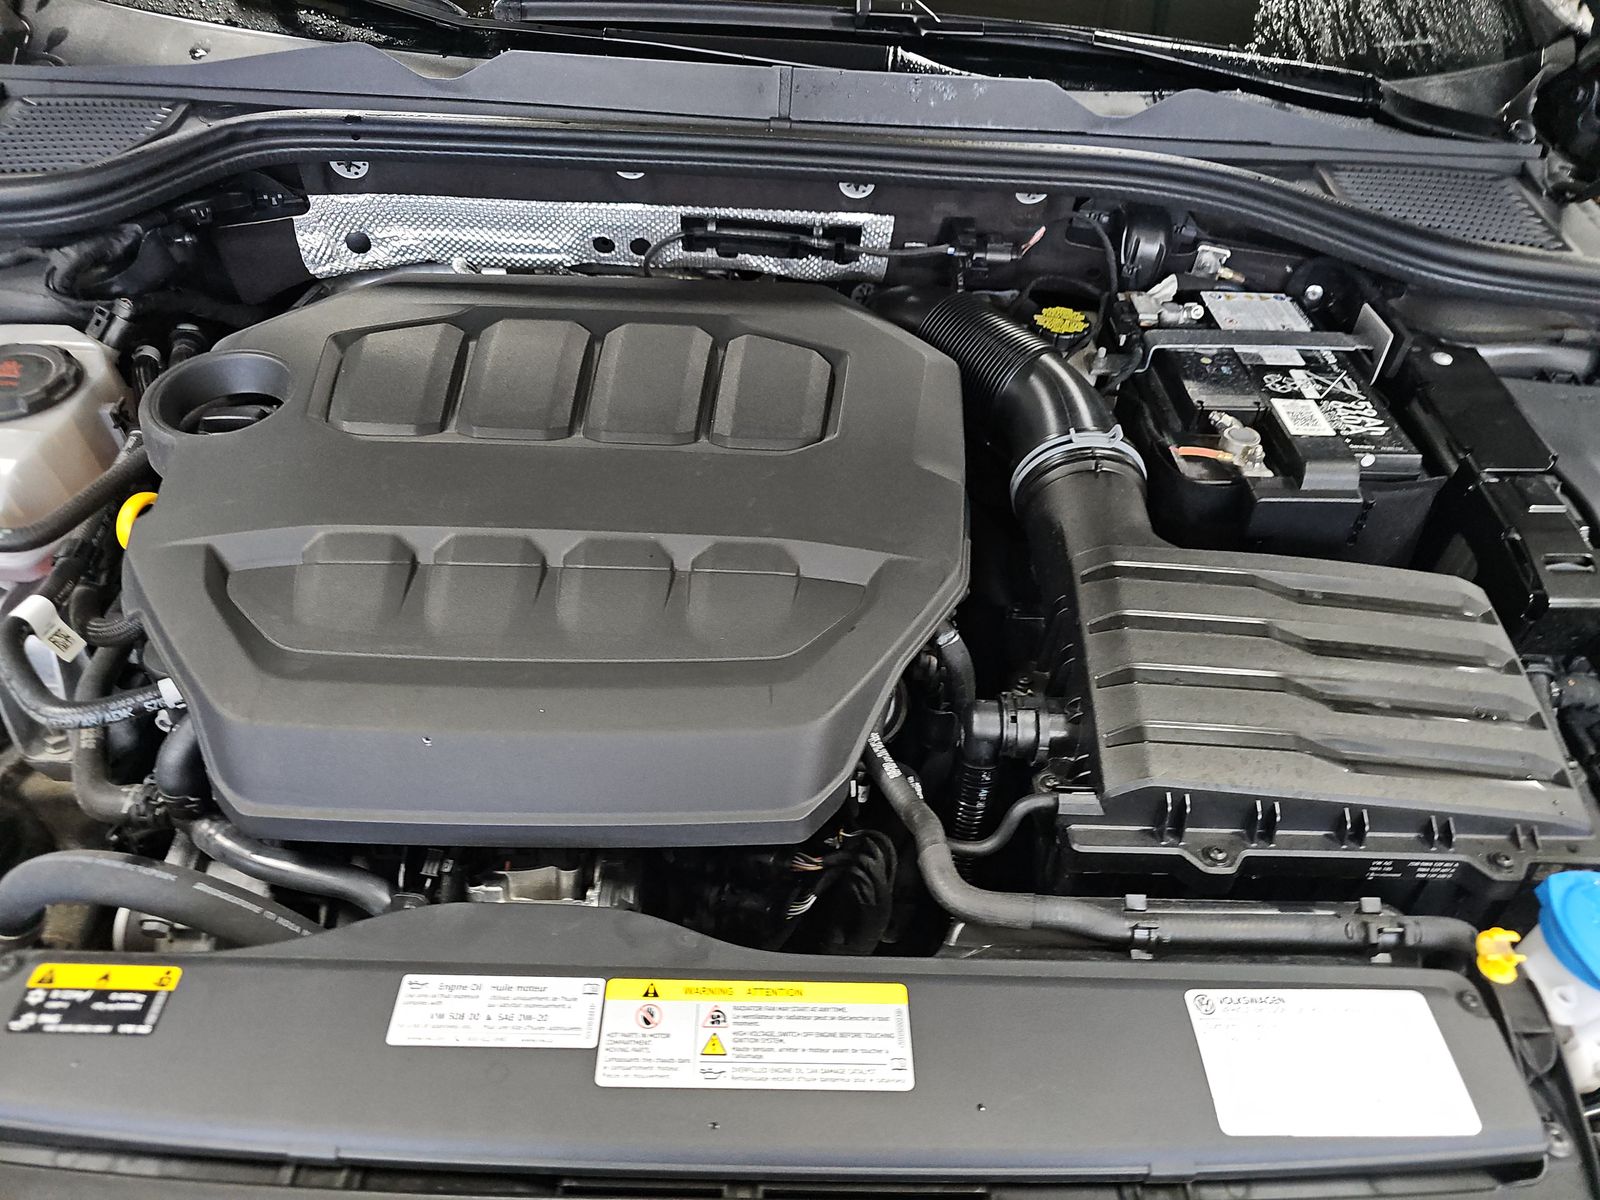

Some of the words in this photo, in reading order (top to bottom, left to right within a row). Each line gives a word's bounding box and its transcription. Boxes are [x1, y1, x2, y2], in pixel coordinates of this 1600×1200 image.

[438, 982, 468, 993] Engine
[470, 983, 483, 991] Oil
[684, 986, 733, 996] WARNING
[746, 987, 804, 997] ATTENTION
[1219, 996, 1286, 1005] VOLKSWAGEN
